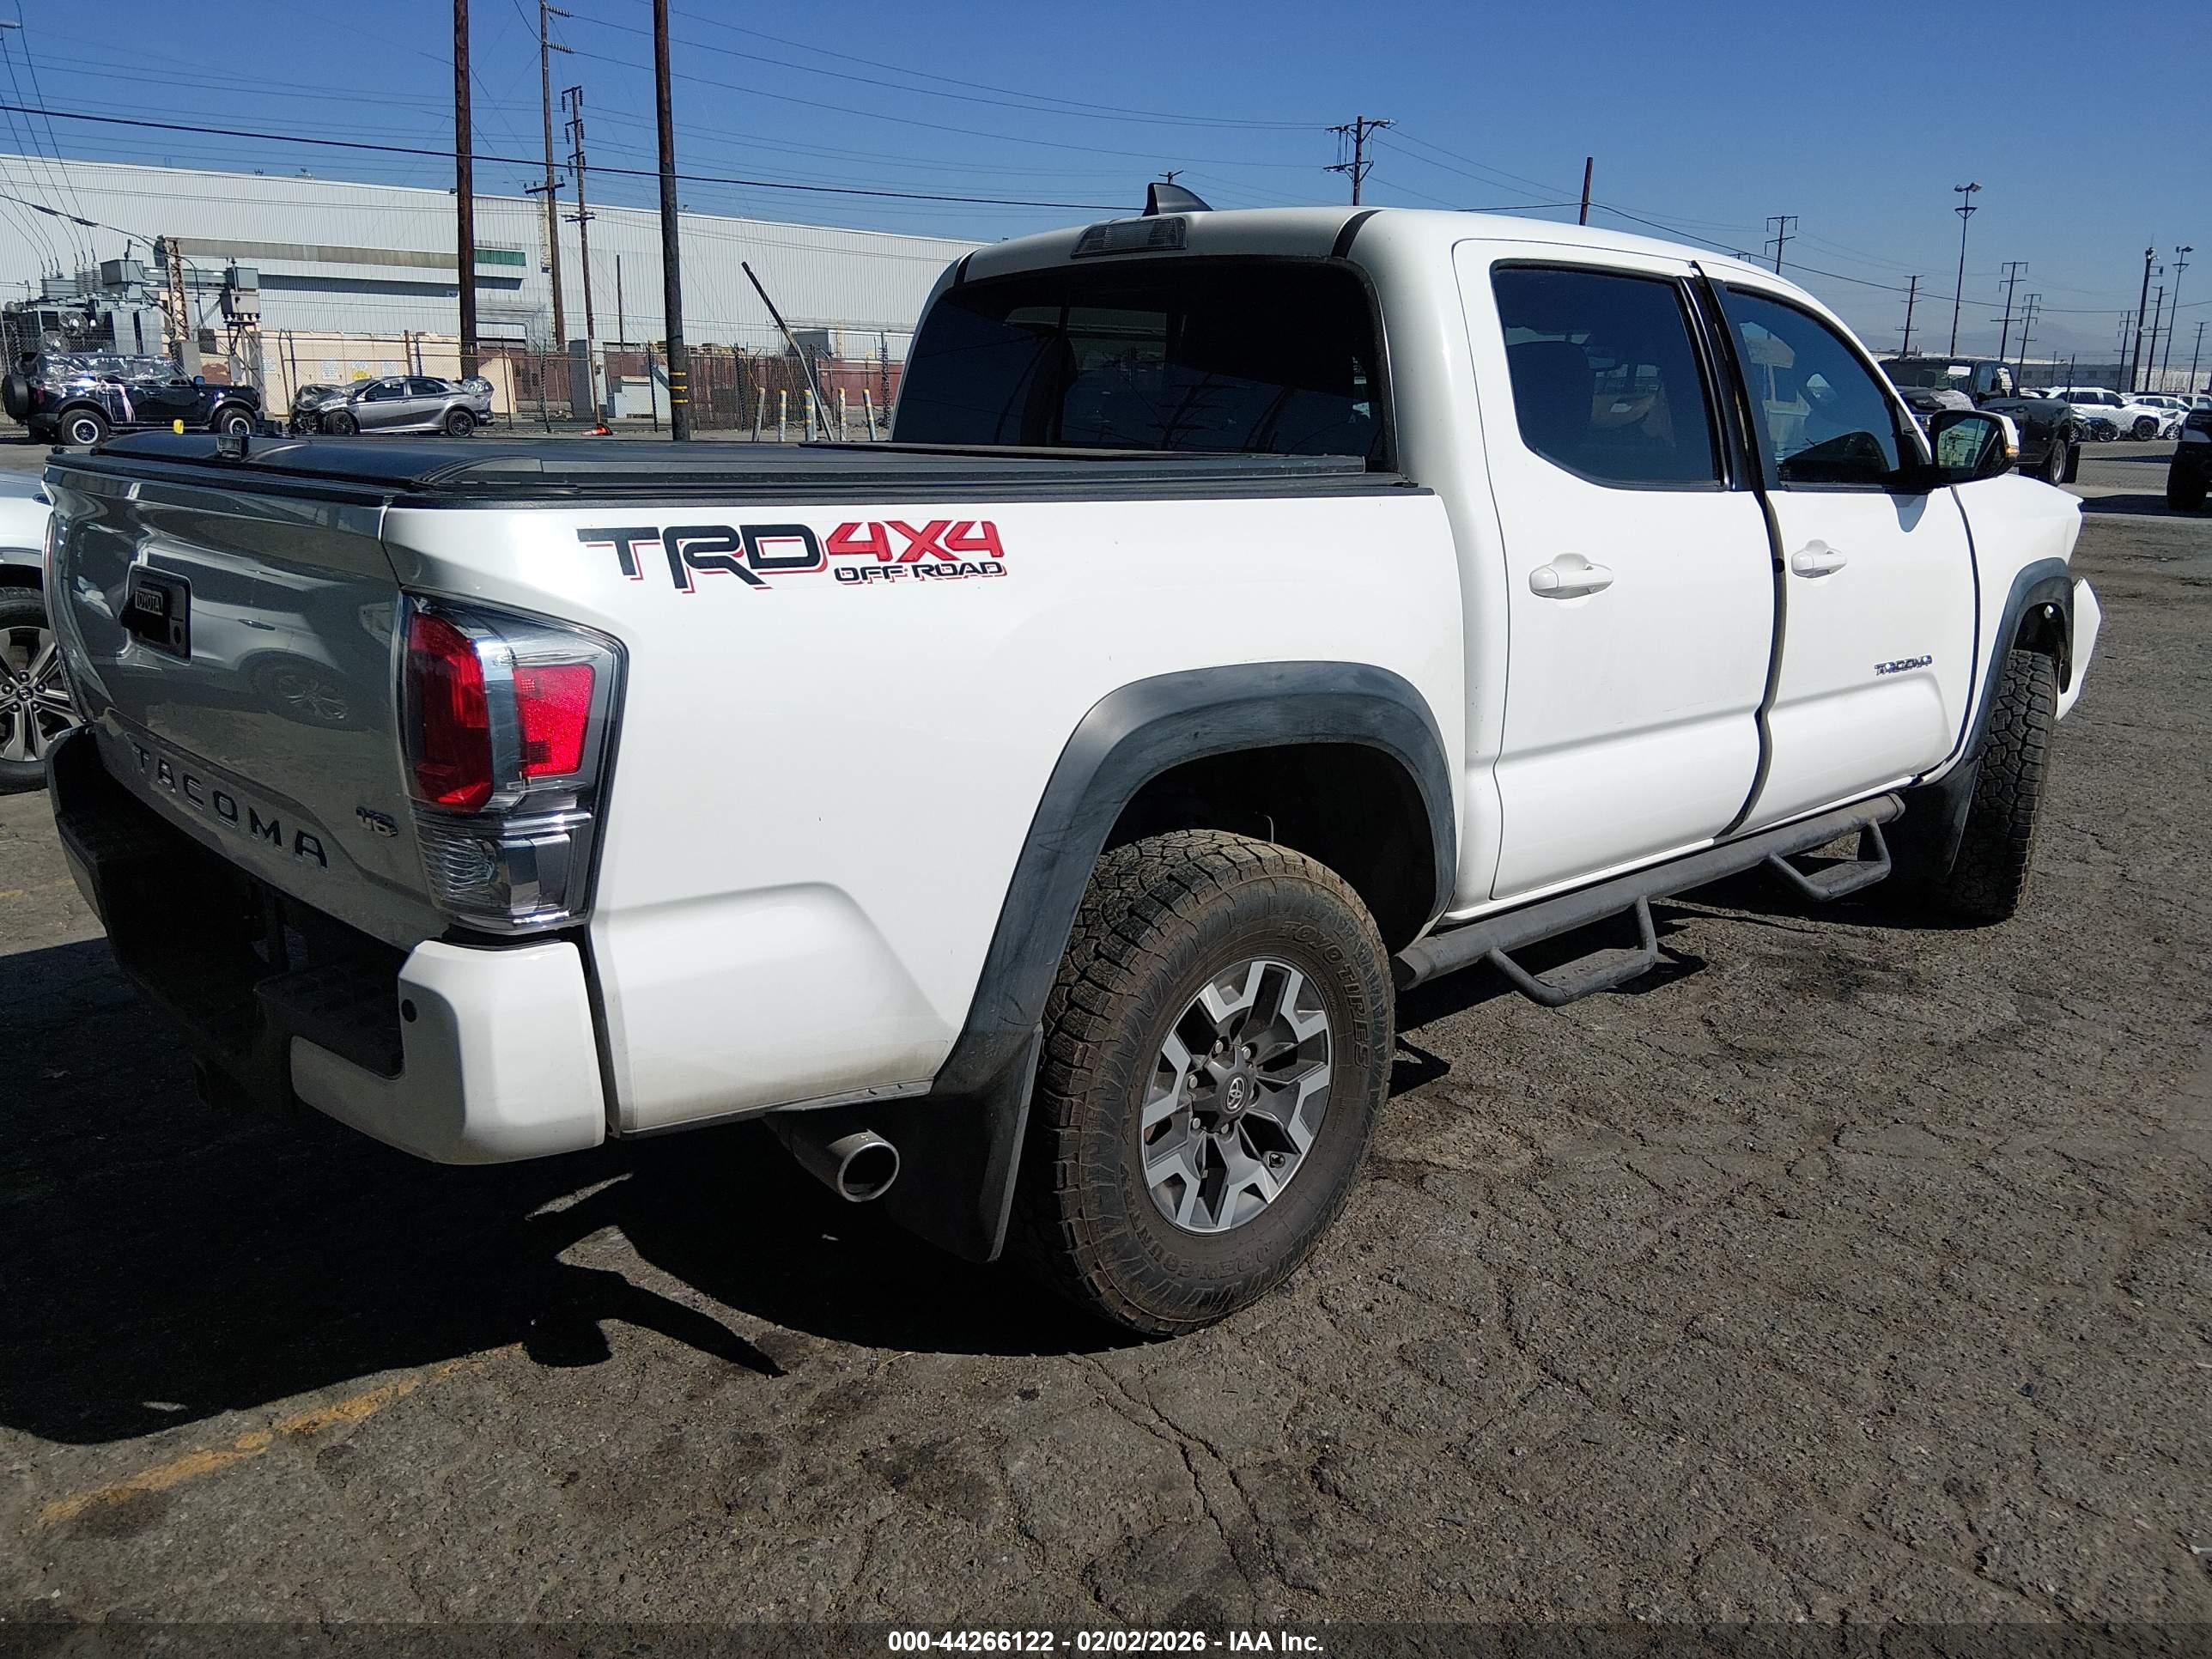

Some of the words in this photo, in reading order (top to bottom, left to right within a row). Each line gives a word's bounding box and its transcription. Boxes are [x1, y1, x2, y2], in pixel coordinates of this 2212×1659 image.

[576, 523, 828, 593] TRD
[825, 519, 1005, 563] 4X4
[834, 565, 907, 586] OFF
[912, 561, 1008, 584] ROAD
[135, 591, 161, 612] TOYOTA
[132, 741, 329, 872] TACOMA
[1336, 963, 1372, 1070] TIRES
